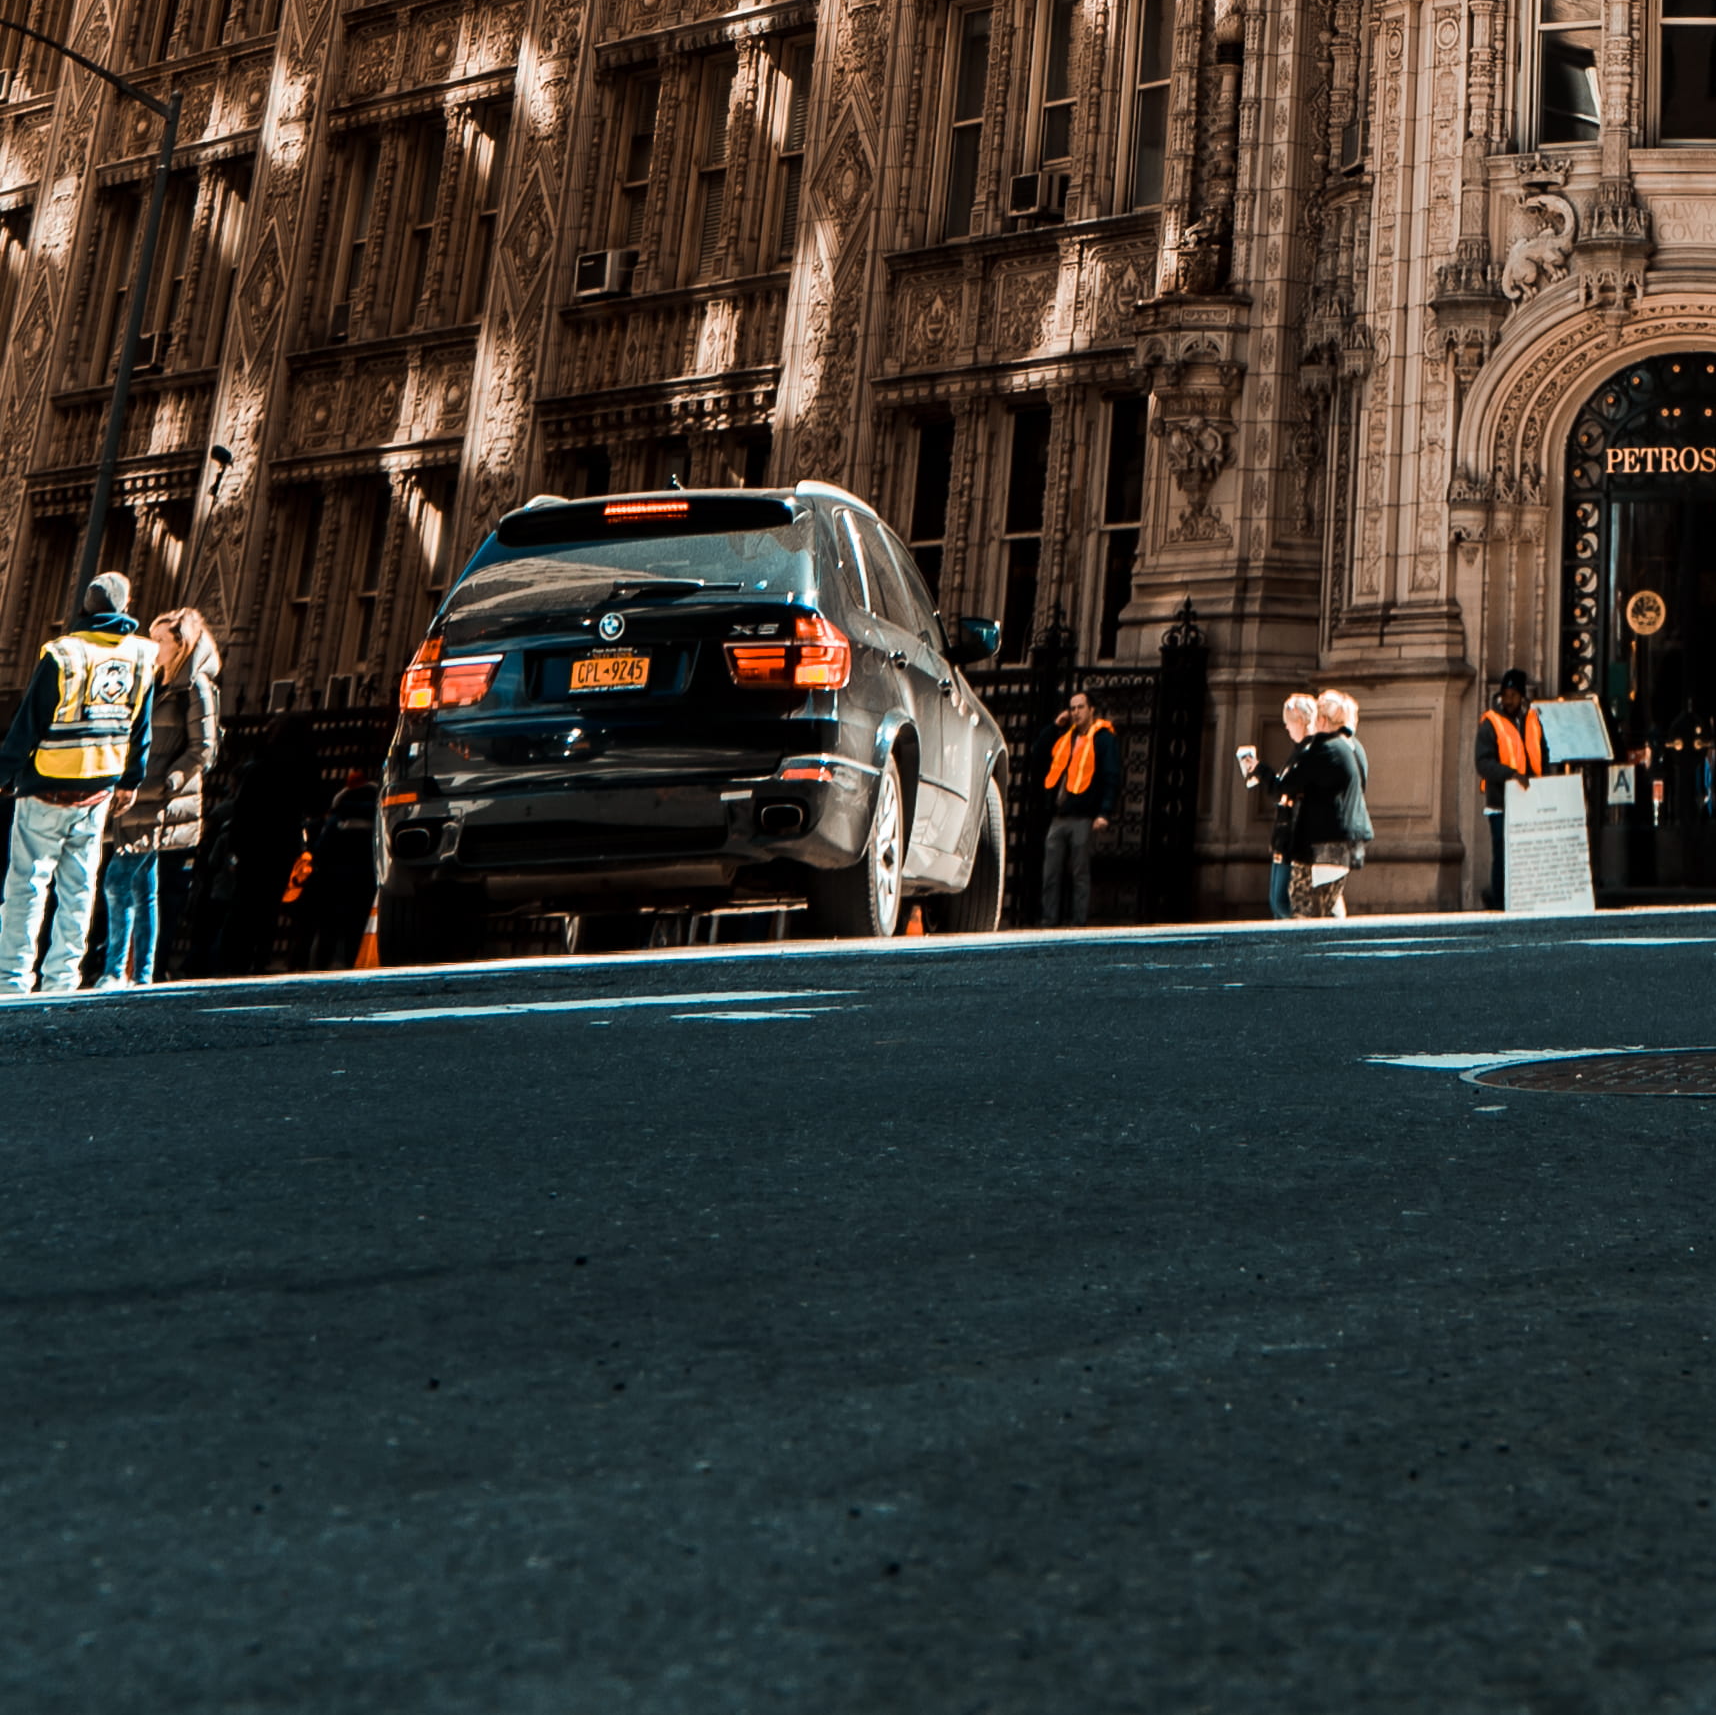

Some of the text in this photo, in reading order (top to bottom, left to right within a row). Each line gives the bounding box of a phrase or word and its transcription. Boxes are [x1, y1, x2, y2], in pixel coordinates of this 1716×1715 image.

[728, 623, 779, 637] X5
[577, 659, 644, 683] CPL 9245
[1613, 769, 1630, 793] A
